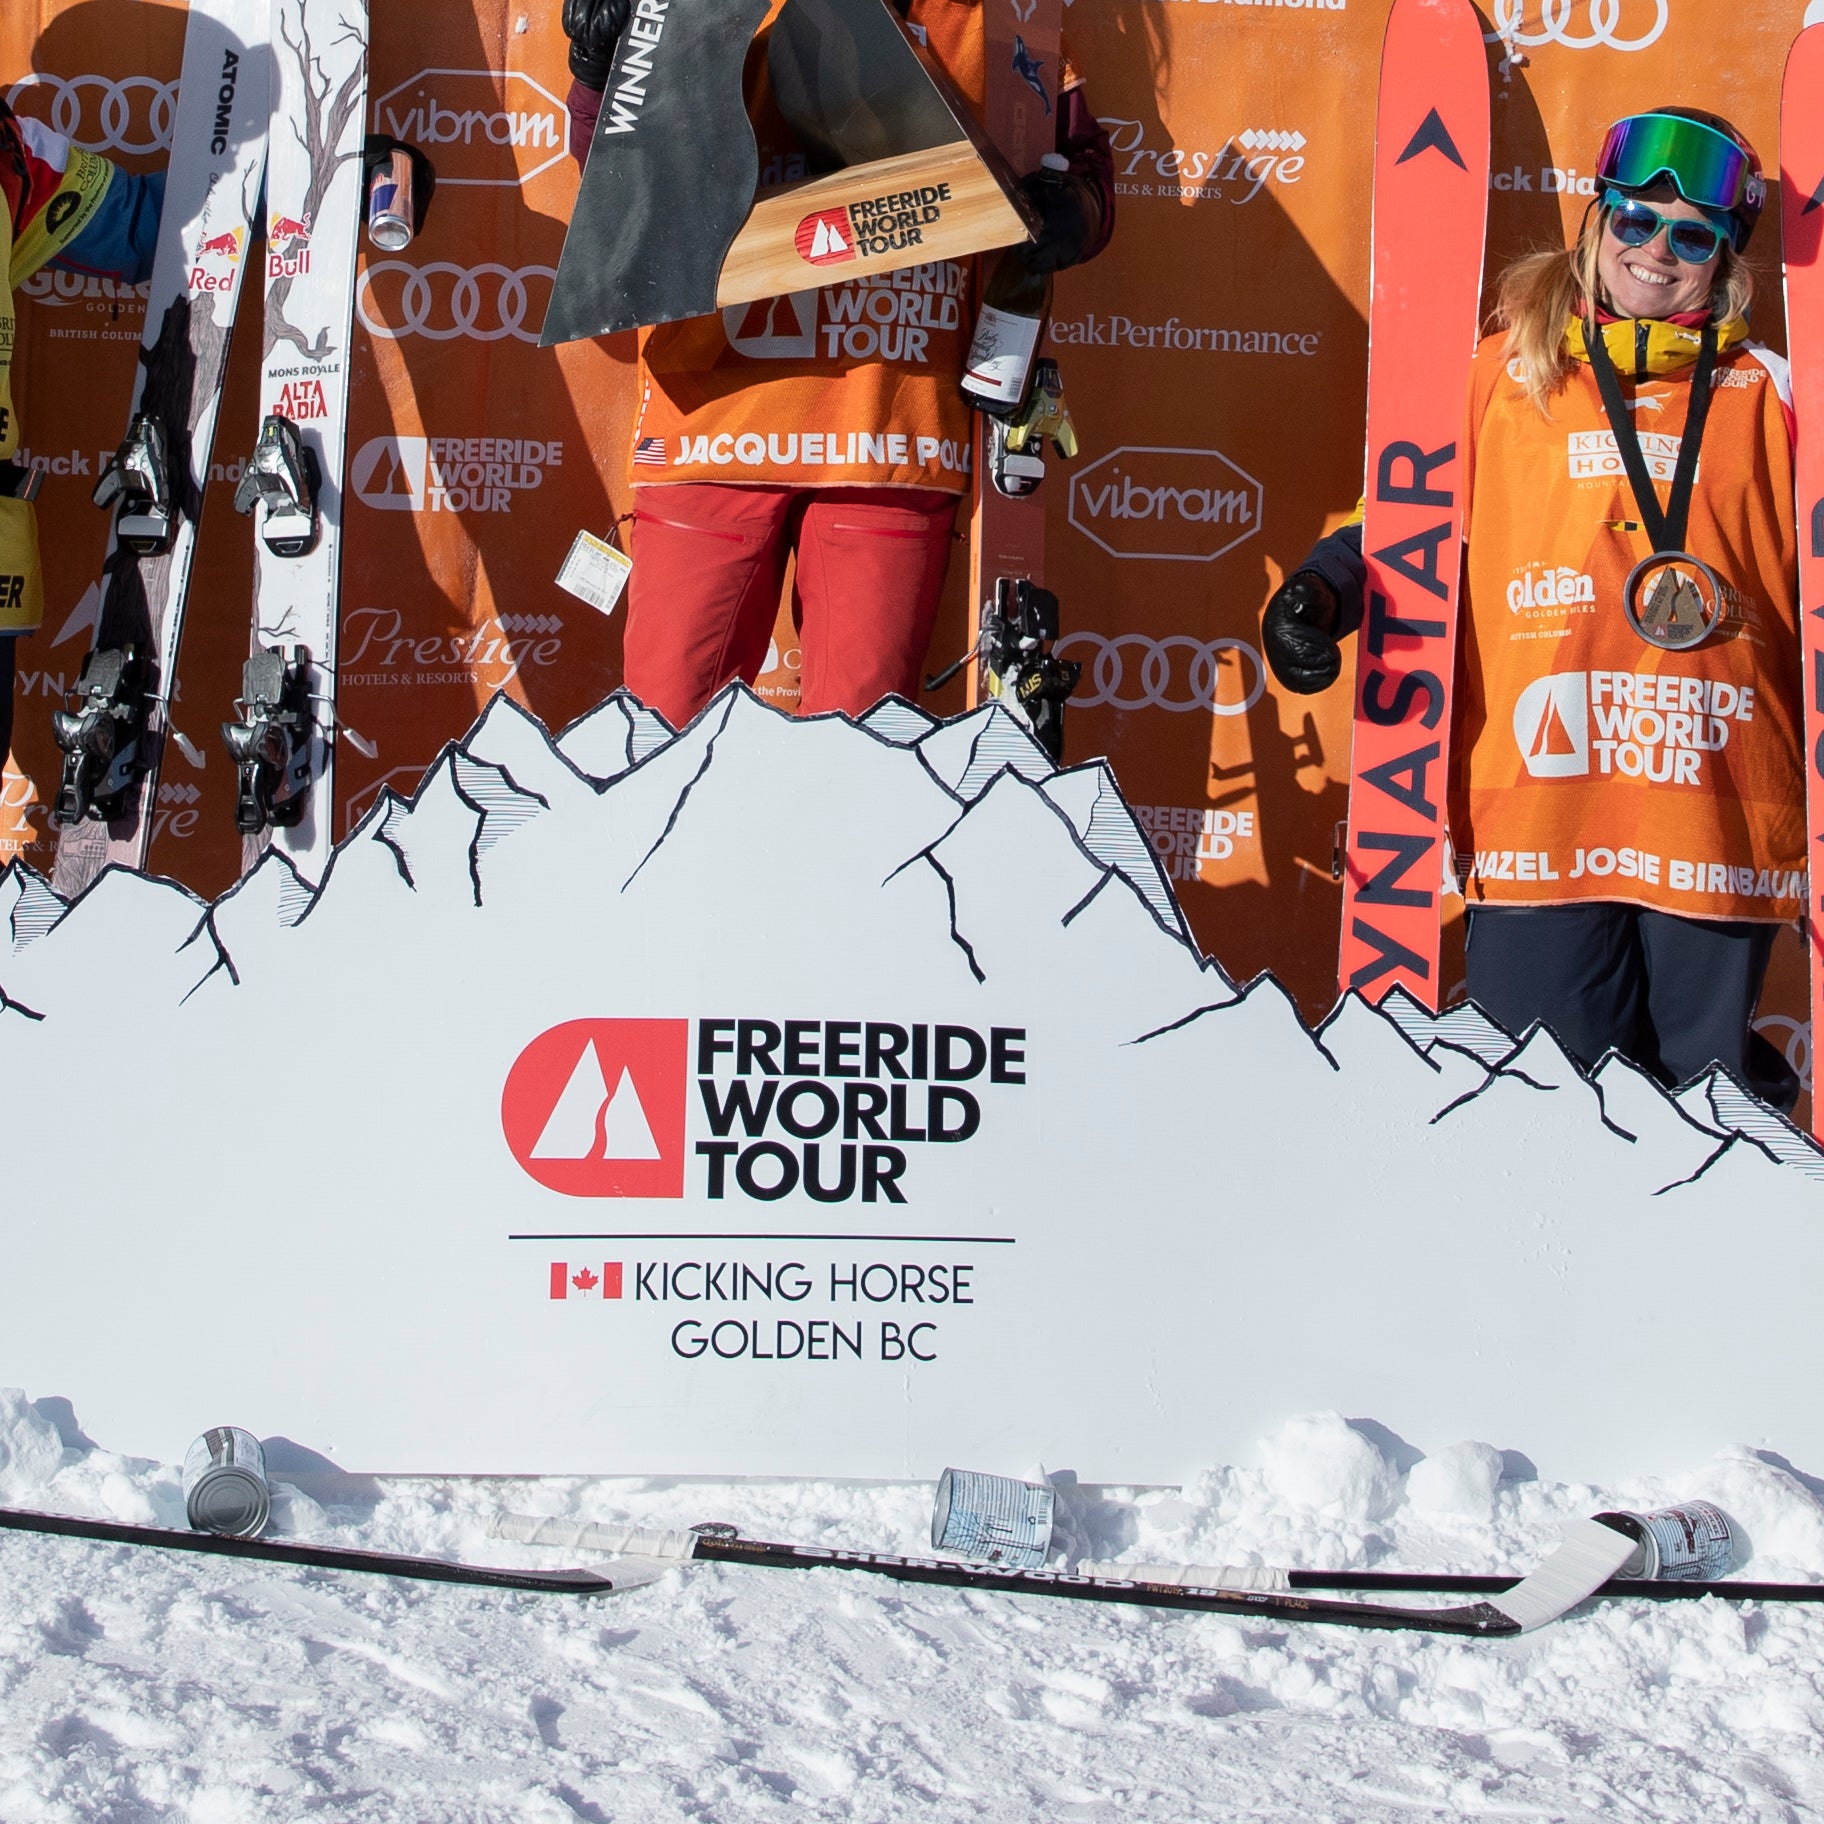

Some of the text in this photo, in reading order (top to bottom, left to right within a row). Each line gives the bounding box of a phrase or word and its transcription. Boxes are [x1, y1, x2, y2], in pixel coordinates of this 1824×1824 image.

[210, 47, 239, 156] ATOMIC
[386, 91, 559, 148] vibram
[1094, 116, 1305, 204] Prestige
[849, 182, 952, 221] FREERIDE
[1157, 184, 1222, 200] RESORTS
[852, 204, 941, 239] WORLD
[856, 228, 922, 258] TOUR
[188, 267, 236, 293] Red
[269, 251, 312, 278] Bull
[823, 288, 960, 332] WORLD
[49, 329, 96, 340] BRITISH
[822, 324, 929, 363] TOUR
[268, 363, 341, 379] MONS ROYALE
[280, 380, 323, 402] ALTA
[430, 438, 563, 467] FREERIDE
[673, 432, 908, 468] JACQUELINE
[429, 462, 543, 490] WORLD
[1081, 467, 1253, 525] vibram
[428, 485, 511, 513] TOUR
[341, 607, 563, 688] Prestige
[342, 670, 478, 686] HOTELS RESORTS
[1591, 671, 1754, 723] FREERIDE
[1350, 440, 1457, 989] YNASTAR
[1594, 707, 1729, 752] WORLD
[1593, 739, 1701, 786] TOUR
[1474, 847, 1810, 901] HAZEL JOSIE BIRNBAUM
[698, 1018, 1026, 1085] FREERIDE
[698, 1079, 981, 1143] WORLD
[696, 1140, 908, 1203] TOUR
[636, 1261, 974, 1304] KICKING HORSE
[671, 1318, 938, 1361] GOLDEN BC
